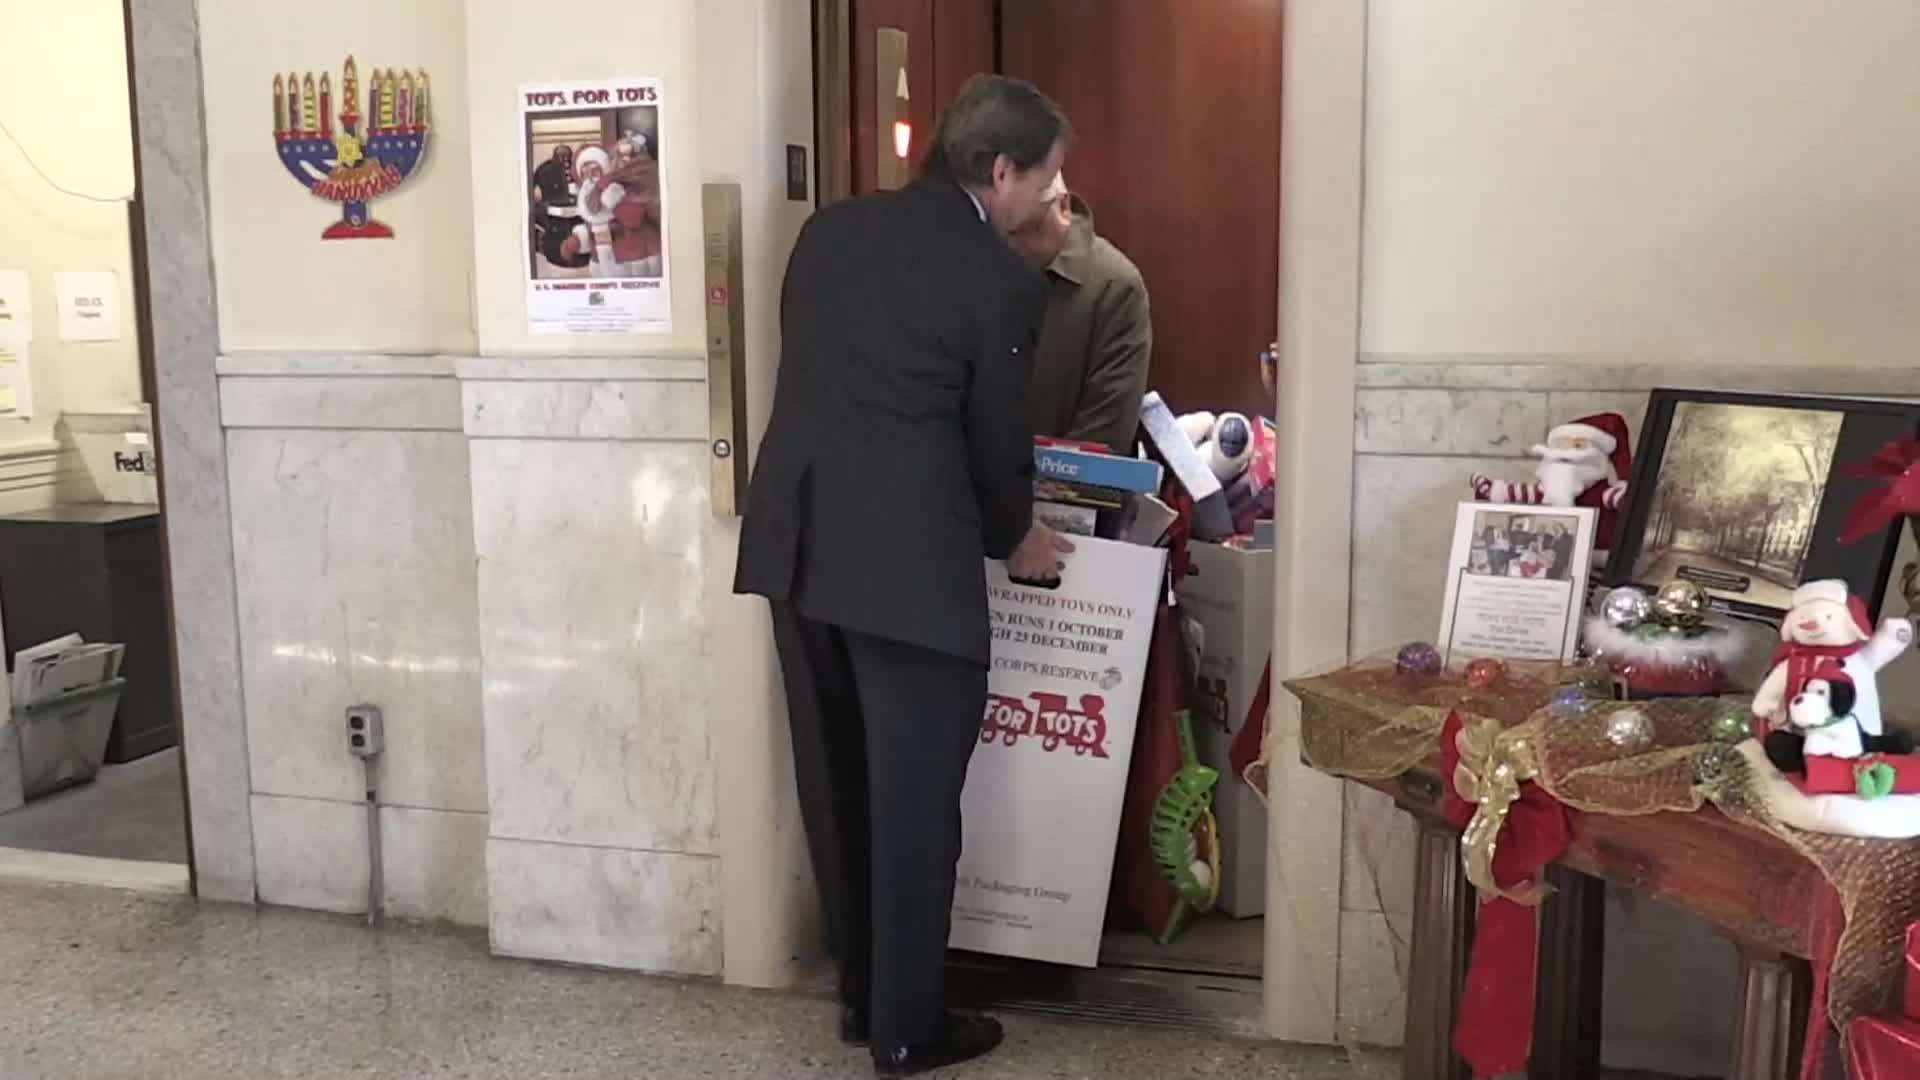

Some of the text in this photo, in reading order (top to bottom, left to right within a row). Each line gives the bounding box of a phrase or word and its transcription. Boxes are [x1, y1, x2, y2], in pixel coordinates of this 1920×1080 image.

[616, 87, 658, 102] TOTS
[1060, 598, 1095, 614] TOYS
[1098, 605, 1135, 620] ONLY
[1008, 612, 1045, 630] RUNS
[1058, 622, 1124, 641] OCTOBER
[1014, 631, 1028, 643] 23
[1031, 633, 1109, 655] DECEMBER
[994, 656, 1099, 682] CORPS RESERVE
[984, 699, 1099, 743] FOR TOTS
